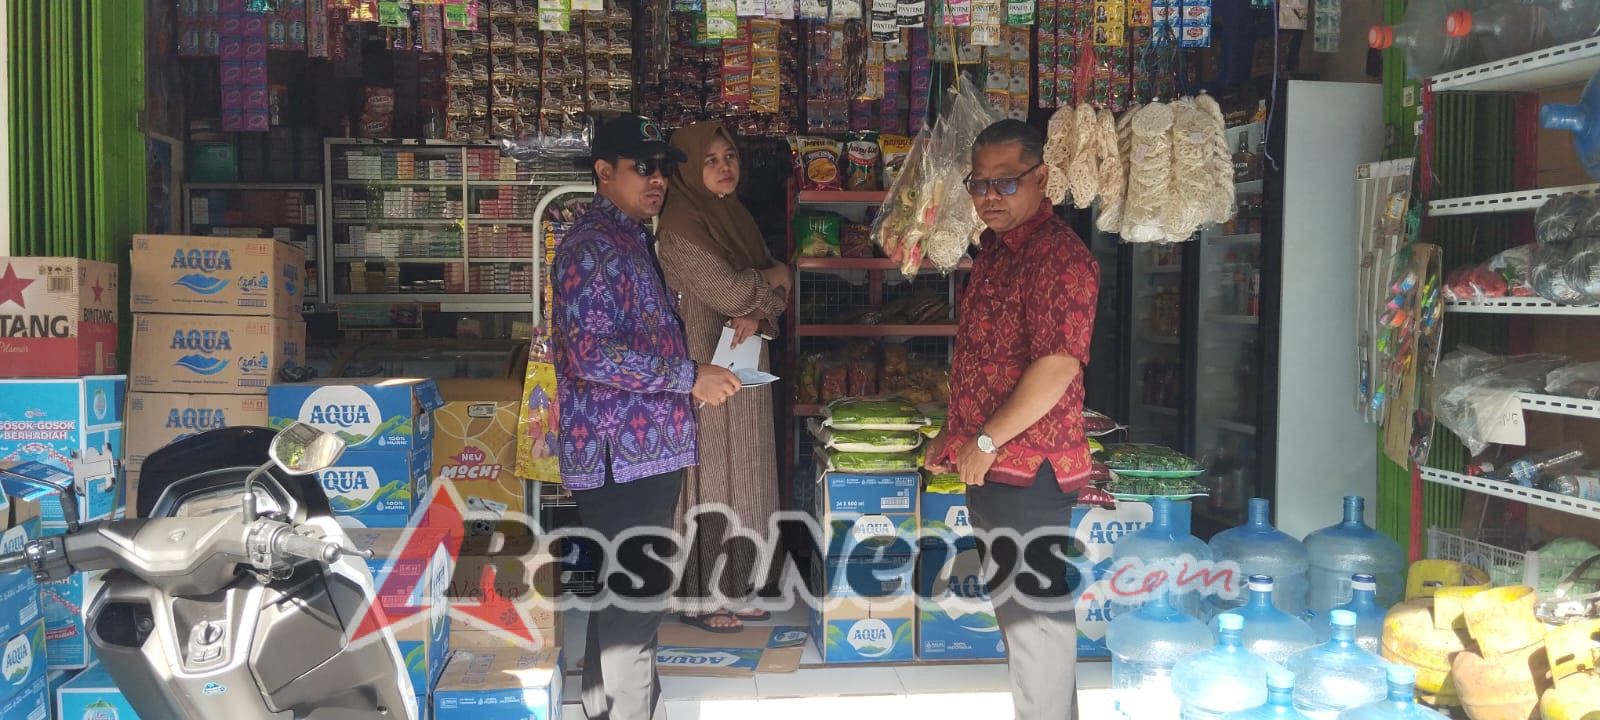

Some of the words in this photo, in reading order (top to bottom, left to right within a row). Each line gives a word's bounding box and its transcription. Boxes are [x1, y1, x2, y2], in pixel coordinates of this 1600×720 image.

[171, 248, 232, 273] AQUA
[84, 308, 113, 323] BINTANG
[170, 329, 232, 354] AQUA
[165, 408, 227, 432] AQUA
[310, 404, 370, 428] AQUA
[4, 431, 67, 440] BERHADIAH
[857, 523, 890, 536] AQUA
[853, 629, 886, 641] AQUA
[6, 642, 28, 667] AQUA
[657, 655, 727, 665] AQUA
